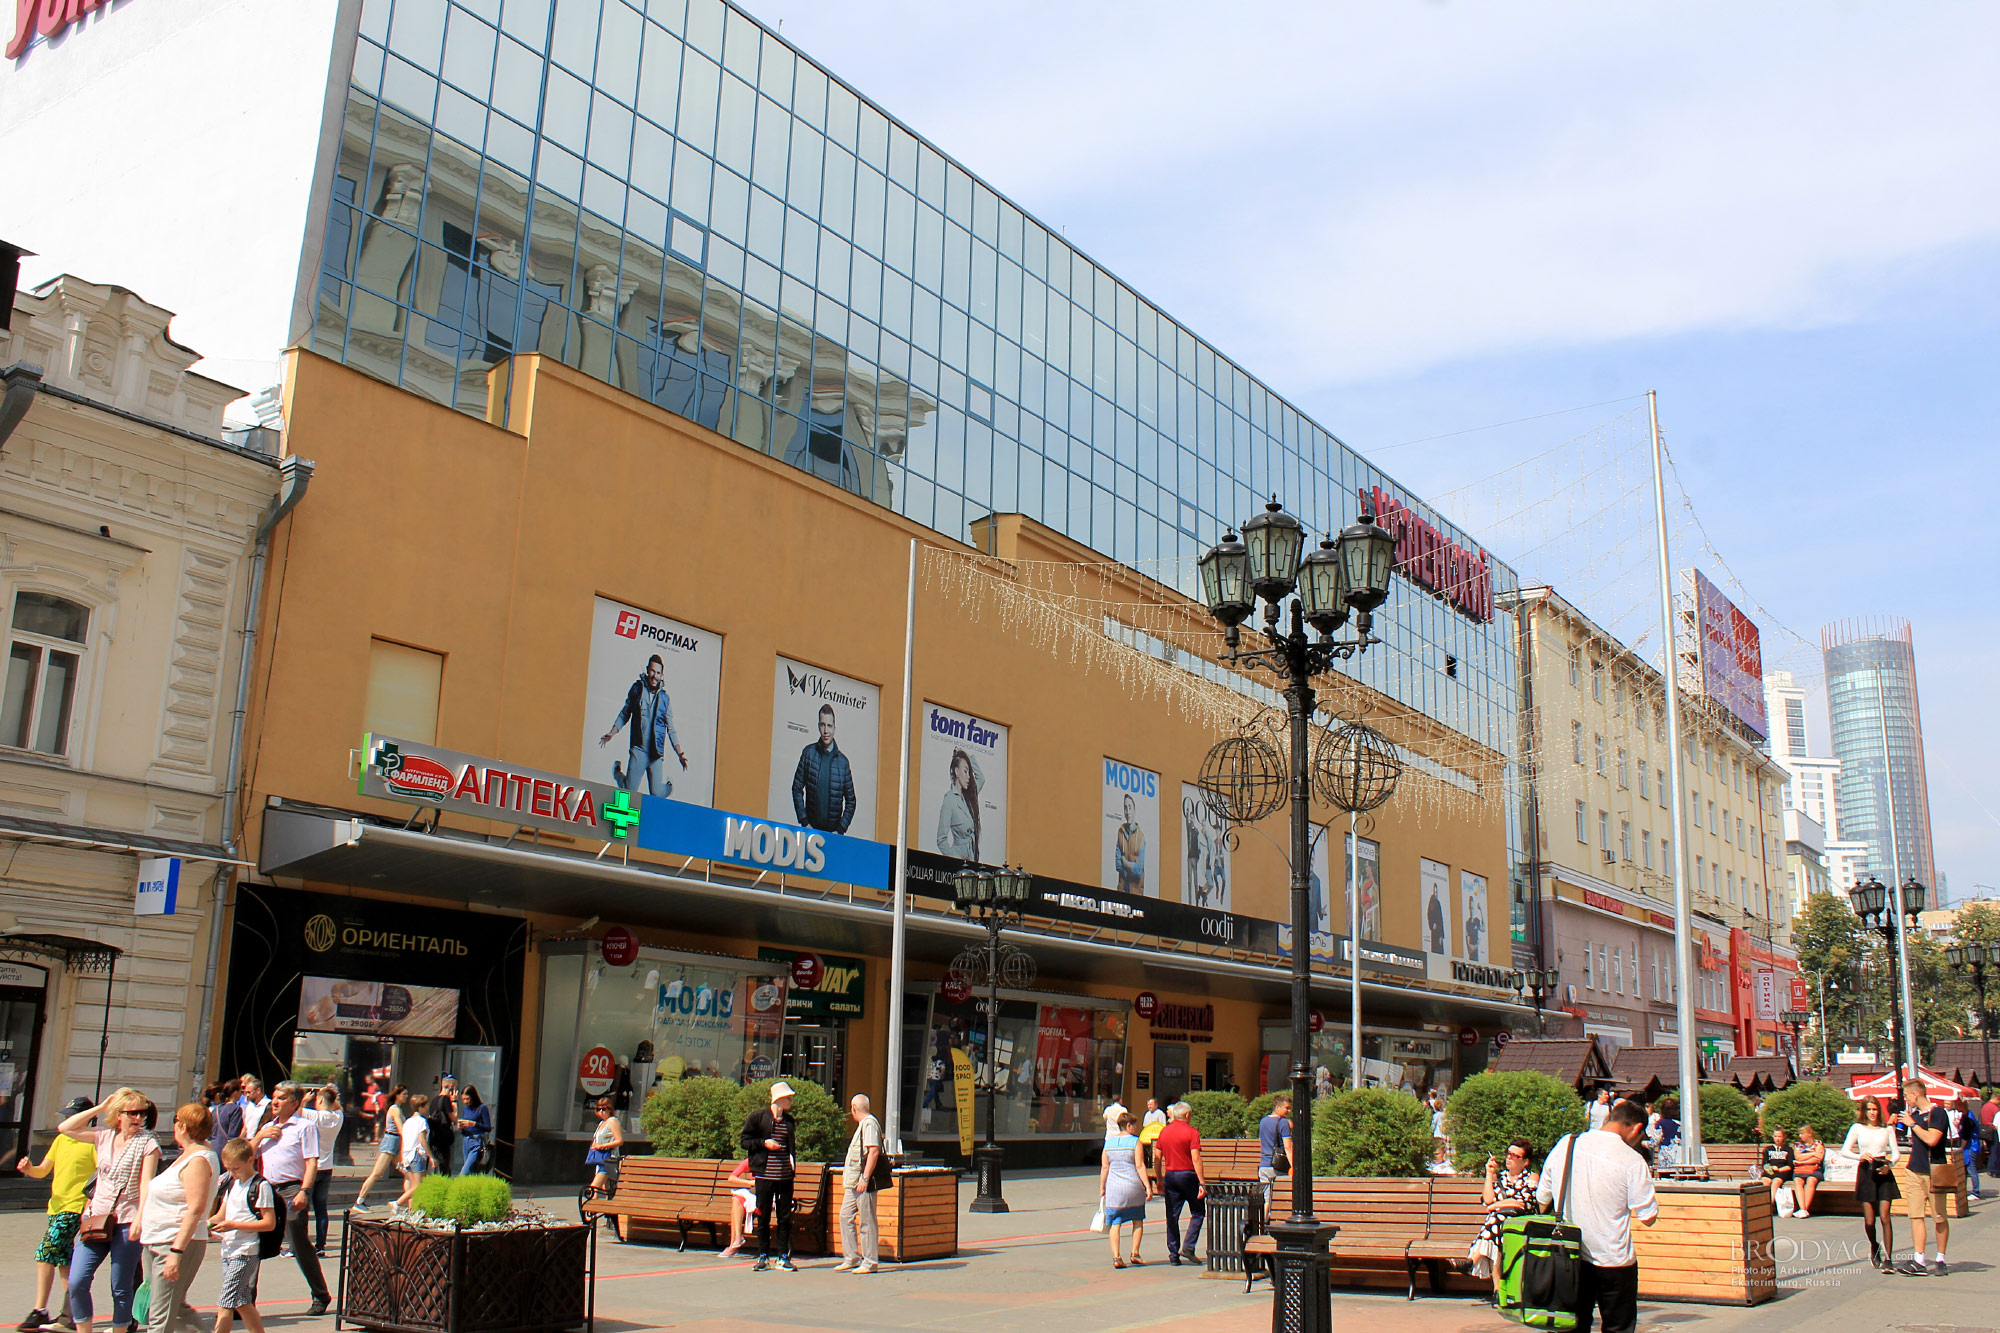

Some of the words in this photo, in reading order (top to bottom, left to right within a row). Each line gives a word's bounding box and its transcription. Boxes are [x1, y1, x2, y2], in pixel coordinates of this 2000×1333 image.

[640, 624, 699, 652] PROFMAX
[808, 675, 867, 711] Westmister
[931, 709, 966, 739] tom
[967, 718, 999, 748] farr
[390, 769, 449, 791] ФАРМЛЕНД
[454, 764, 598, 827] АПТЕКА
[1106, 761, 1155, 798] MODIS
[723, 816, 826, 873] MODIS
[905, 865, 934, 881] ЫСШАЯ
[935, 871, 957, 886] ШКОЛ
[342, 927, 468, 956] ОРИЕНТАЛЬ
[1201, 913, 1234, 945] oodji
[659, 983, 734, 1019] MODIS
[829, 1002, 861, 1012] салаты
[1762, 976, 1771, 1009] ОПТИКА
[1151, 1003, 1215, 1032] СПЕНСКИЙ
